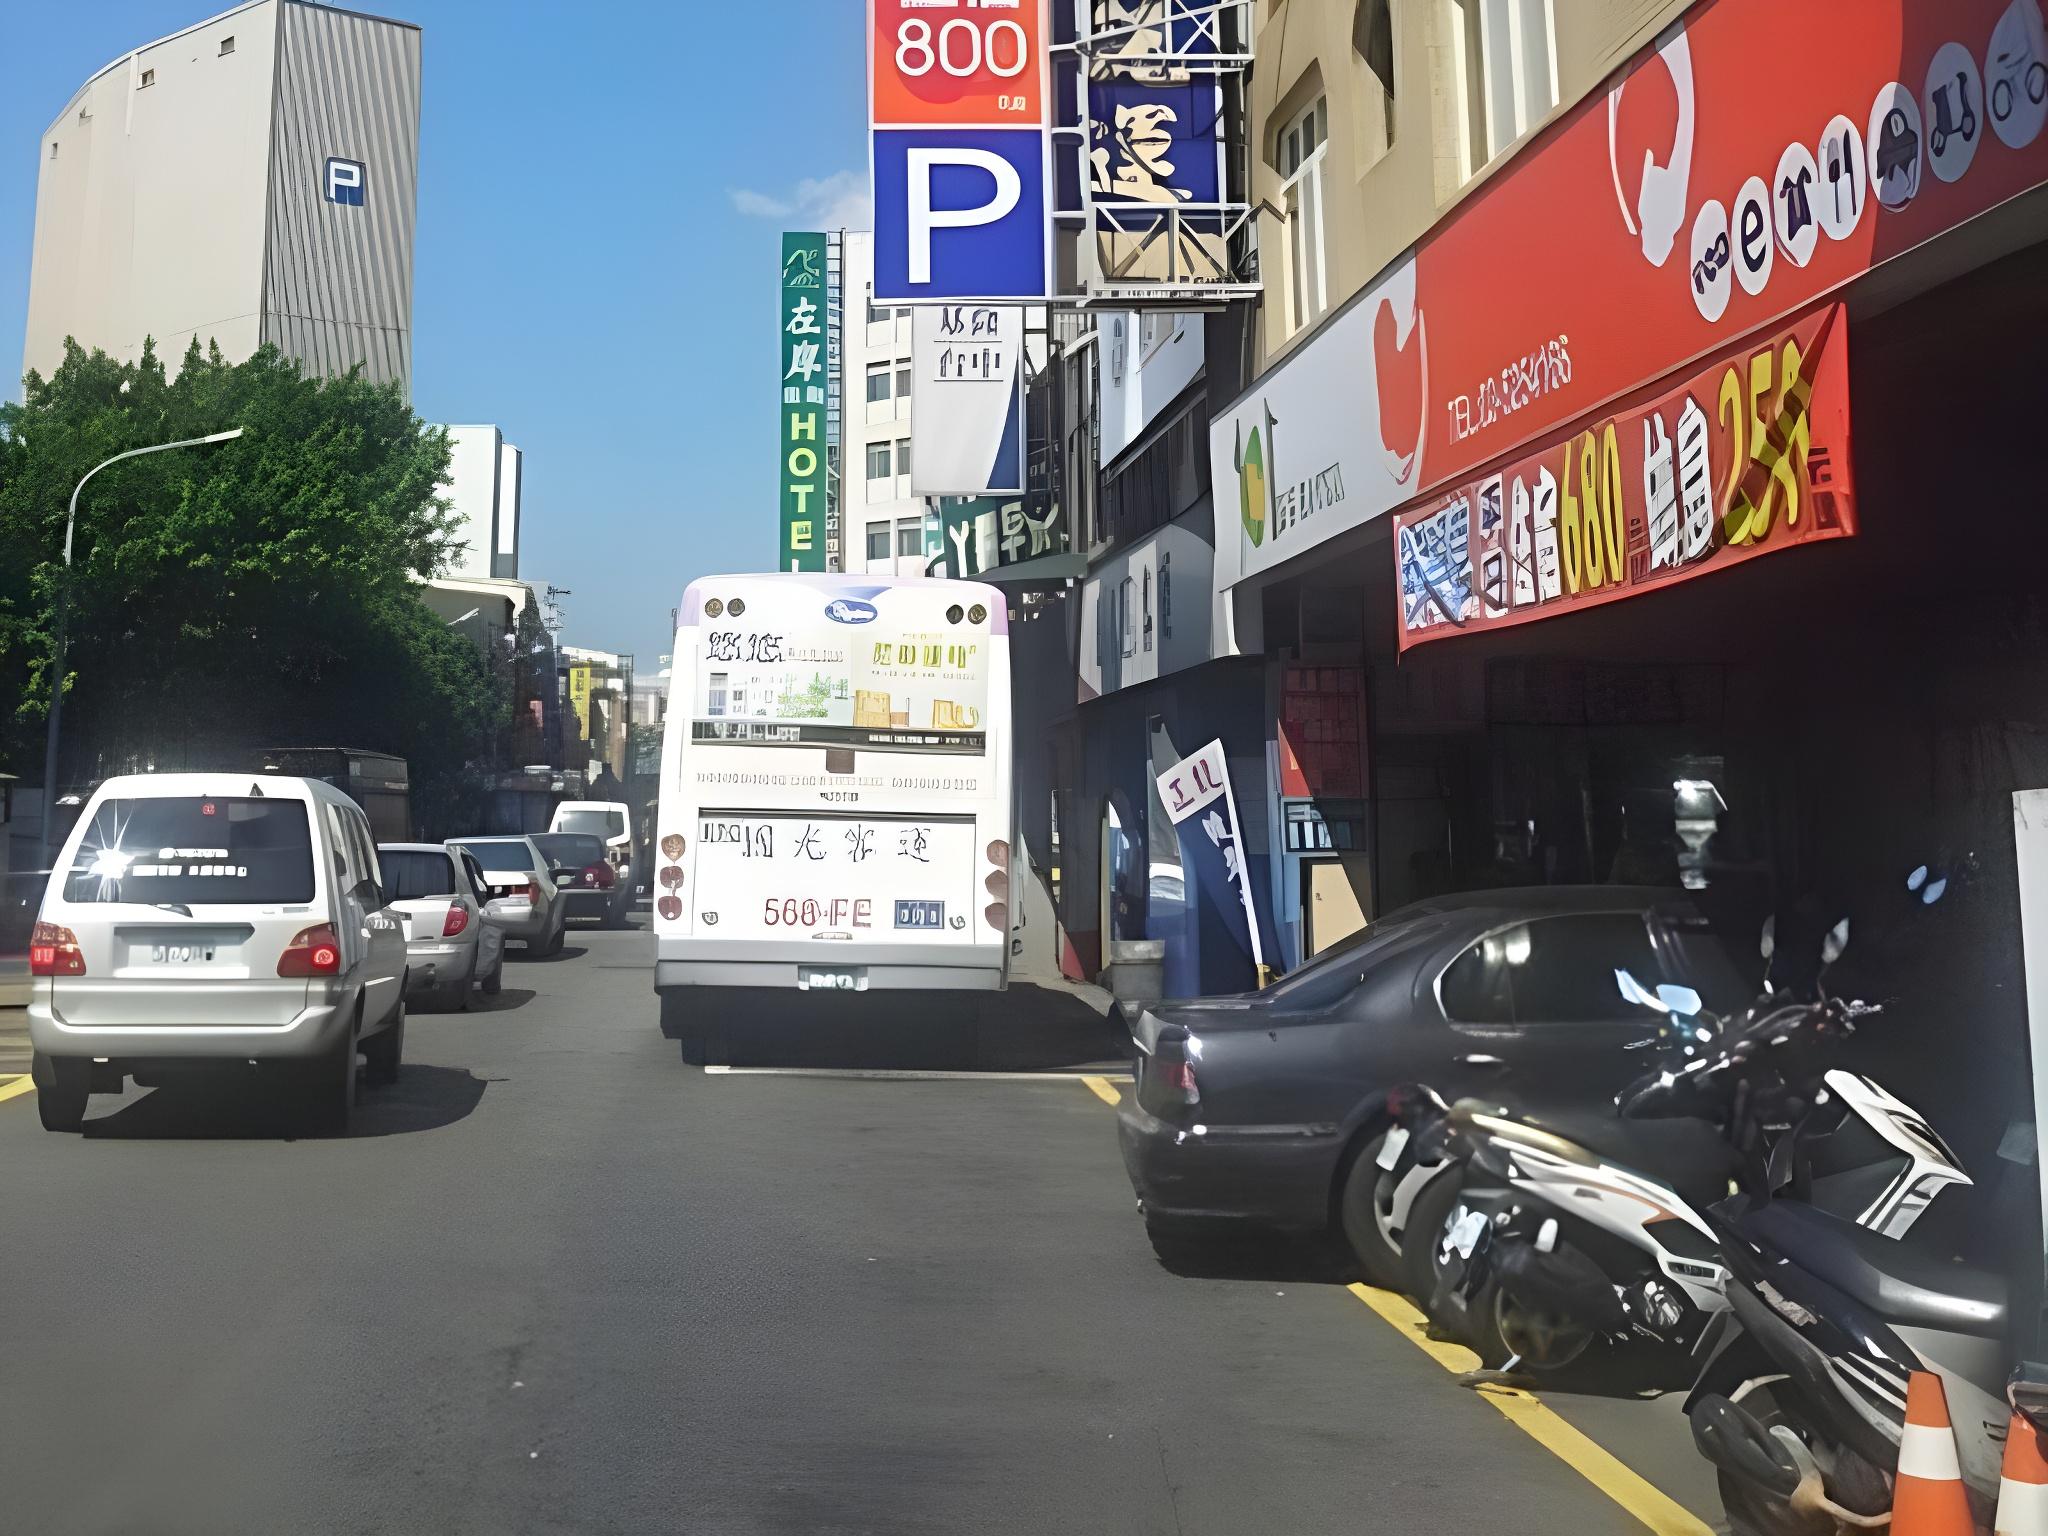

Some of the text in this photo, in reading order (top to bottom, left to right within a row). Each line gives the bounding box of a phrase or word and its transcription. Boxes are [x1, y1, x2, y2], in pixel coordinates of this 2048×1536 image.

[895, 18, 1028, 78] 800
[329, 161, 361, 199] P
[907, 147, 1022, 284] P
